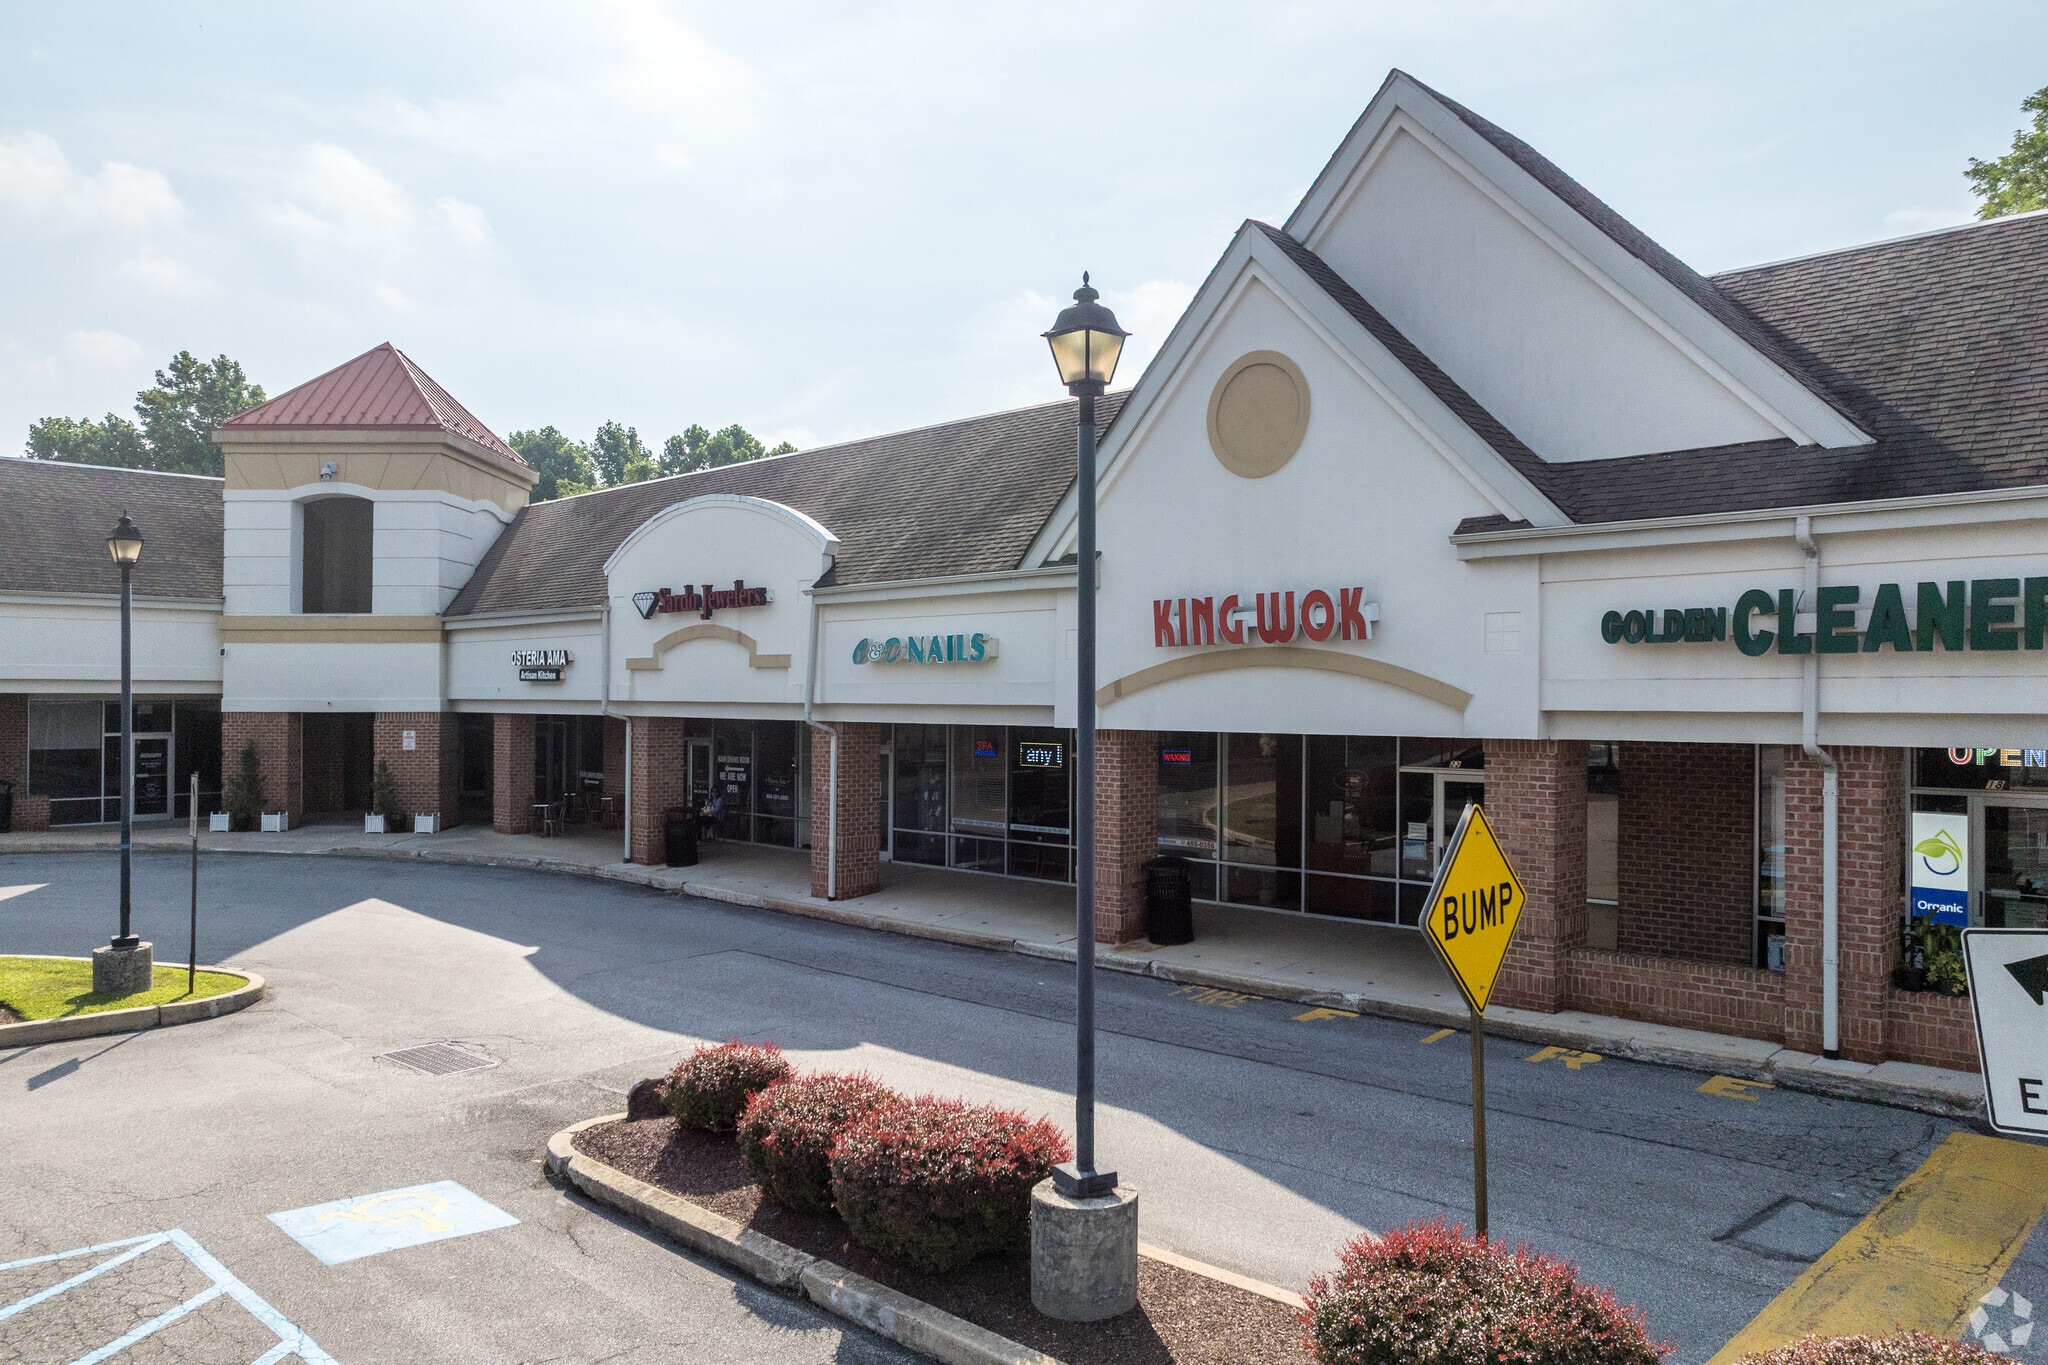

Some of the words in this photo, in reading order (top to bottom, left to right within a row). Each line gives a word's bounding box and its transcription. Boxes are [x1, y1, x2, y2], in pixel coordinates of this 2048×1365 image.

[658, 584, 701, 613] Sardo
[701, 580, 767, 620] Jewelers
[1153, 594, 1246, 648] KING
[1256, 587, 1368, 644] WOK
[1601, 607, 1727, 644] GOLDEN
[908, 632, 987, 664] NAILS
[511, 650, 546, 666] OSTERIA
[546, 650, 567, 666] AMA
[520, 670, 537, 680] Artisan
[537, 670, 556, 680] Kitchen
[977, 740, 993, 750] SPA
[1026, 748, 1052, 766] any
[1163, 753, 1190, 761] WAXING
[1948, 747, 2046, 768] OPEN
[1989, 781, 2003, 789] 18
[1443, 881, 1513, 941] BUMP
[1917, 900, 1964, 914] Organic
